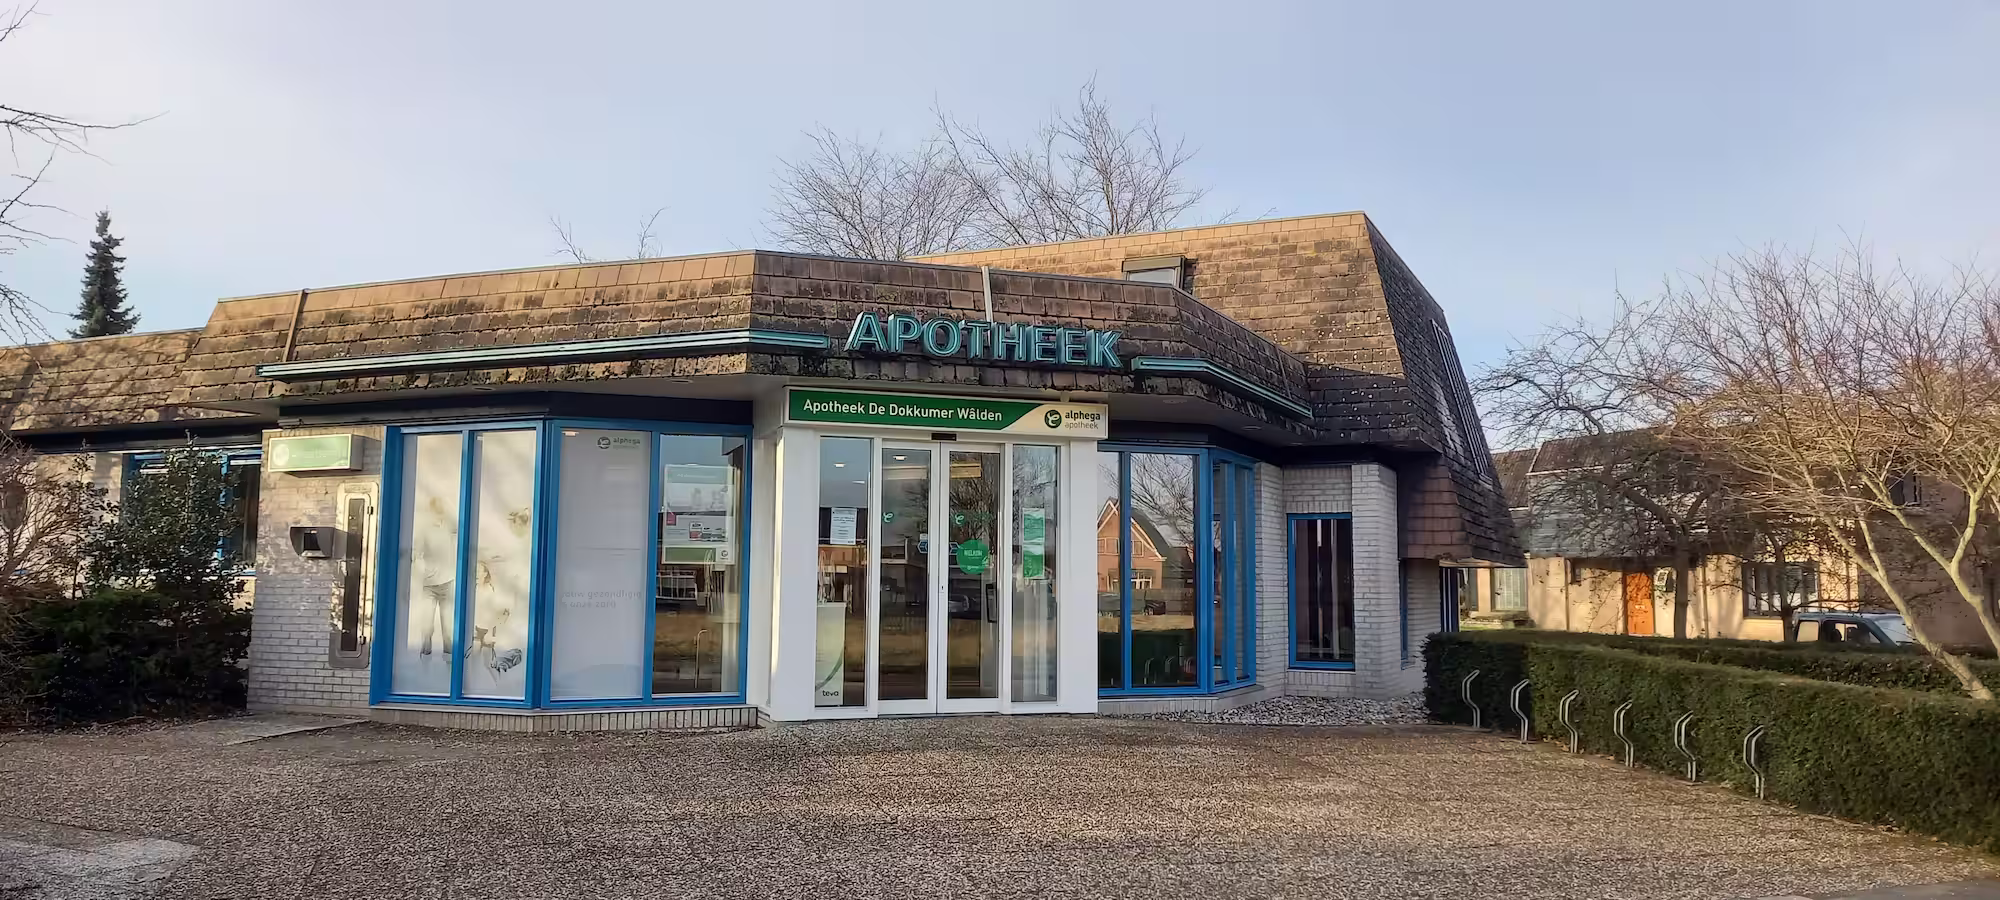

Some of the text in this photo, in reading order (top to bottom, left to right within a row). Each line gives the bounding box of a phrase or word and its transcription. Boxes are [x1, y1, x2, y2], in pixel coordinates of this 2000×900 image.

[845, 311, 1124, 368] APOTHEEK
[803, 399, 1002, 421] Apotheek De Dokkumer Wâlden
[1065, 410, 1100, 422] alphega
[1065, 421, 1099, 430] apotheek
